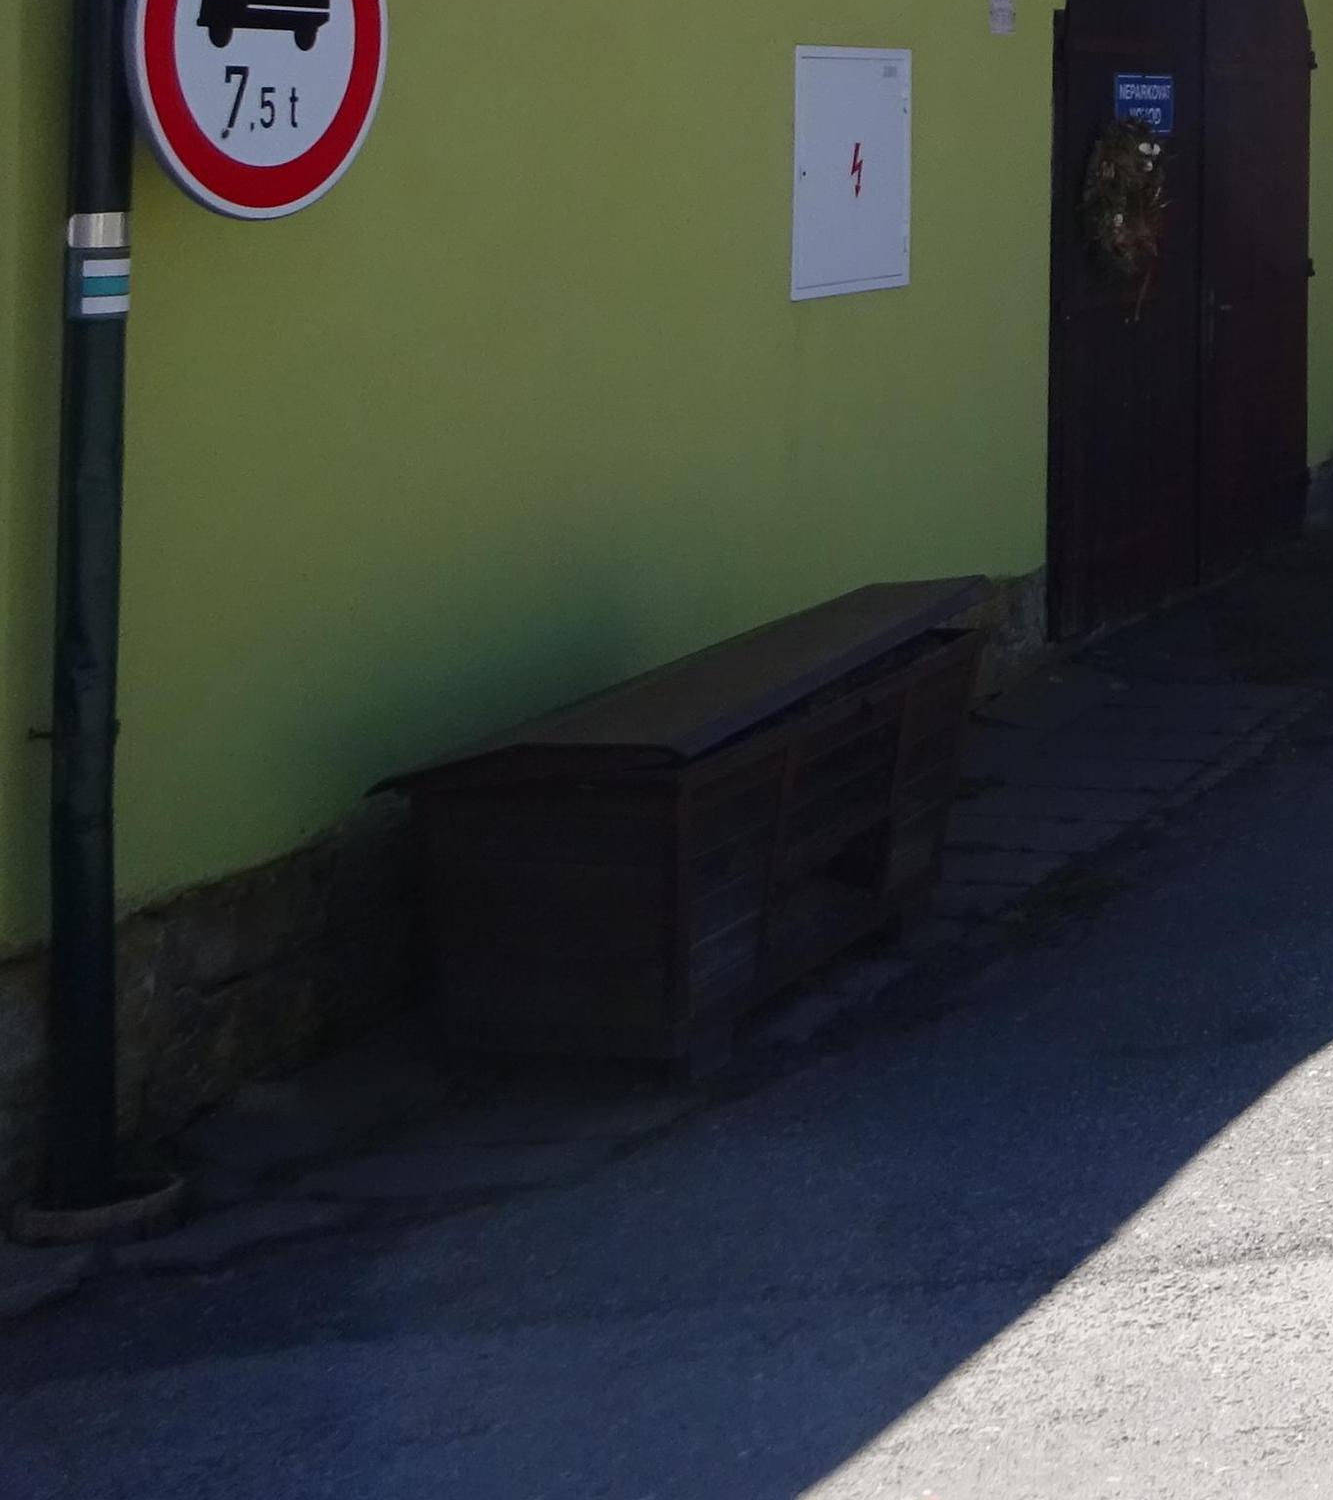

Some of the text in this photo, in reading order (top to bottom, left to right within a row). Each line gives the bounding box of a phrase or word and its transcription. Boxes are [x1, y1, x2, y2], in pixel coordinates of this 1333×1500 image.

[222, 65, 299, 139] 7,5 t
[1118, 83, 1171, 101] NEPARKOVAT
